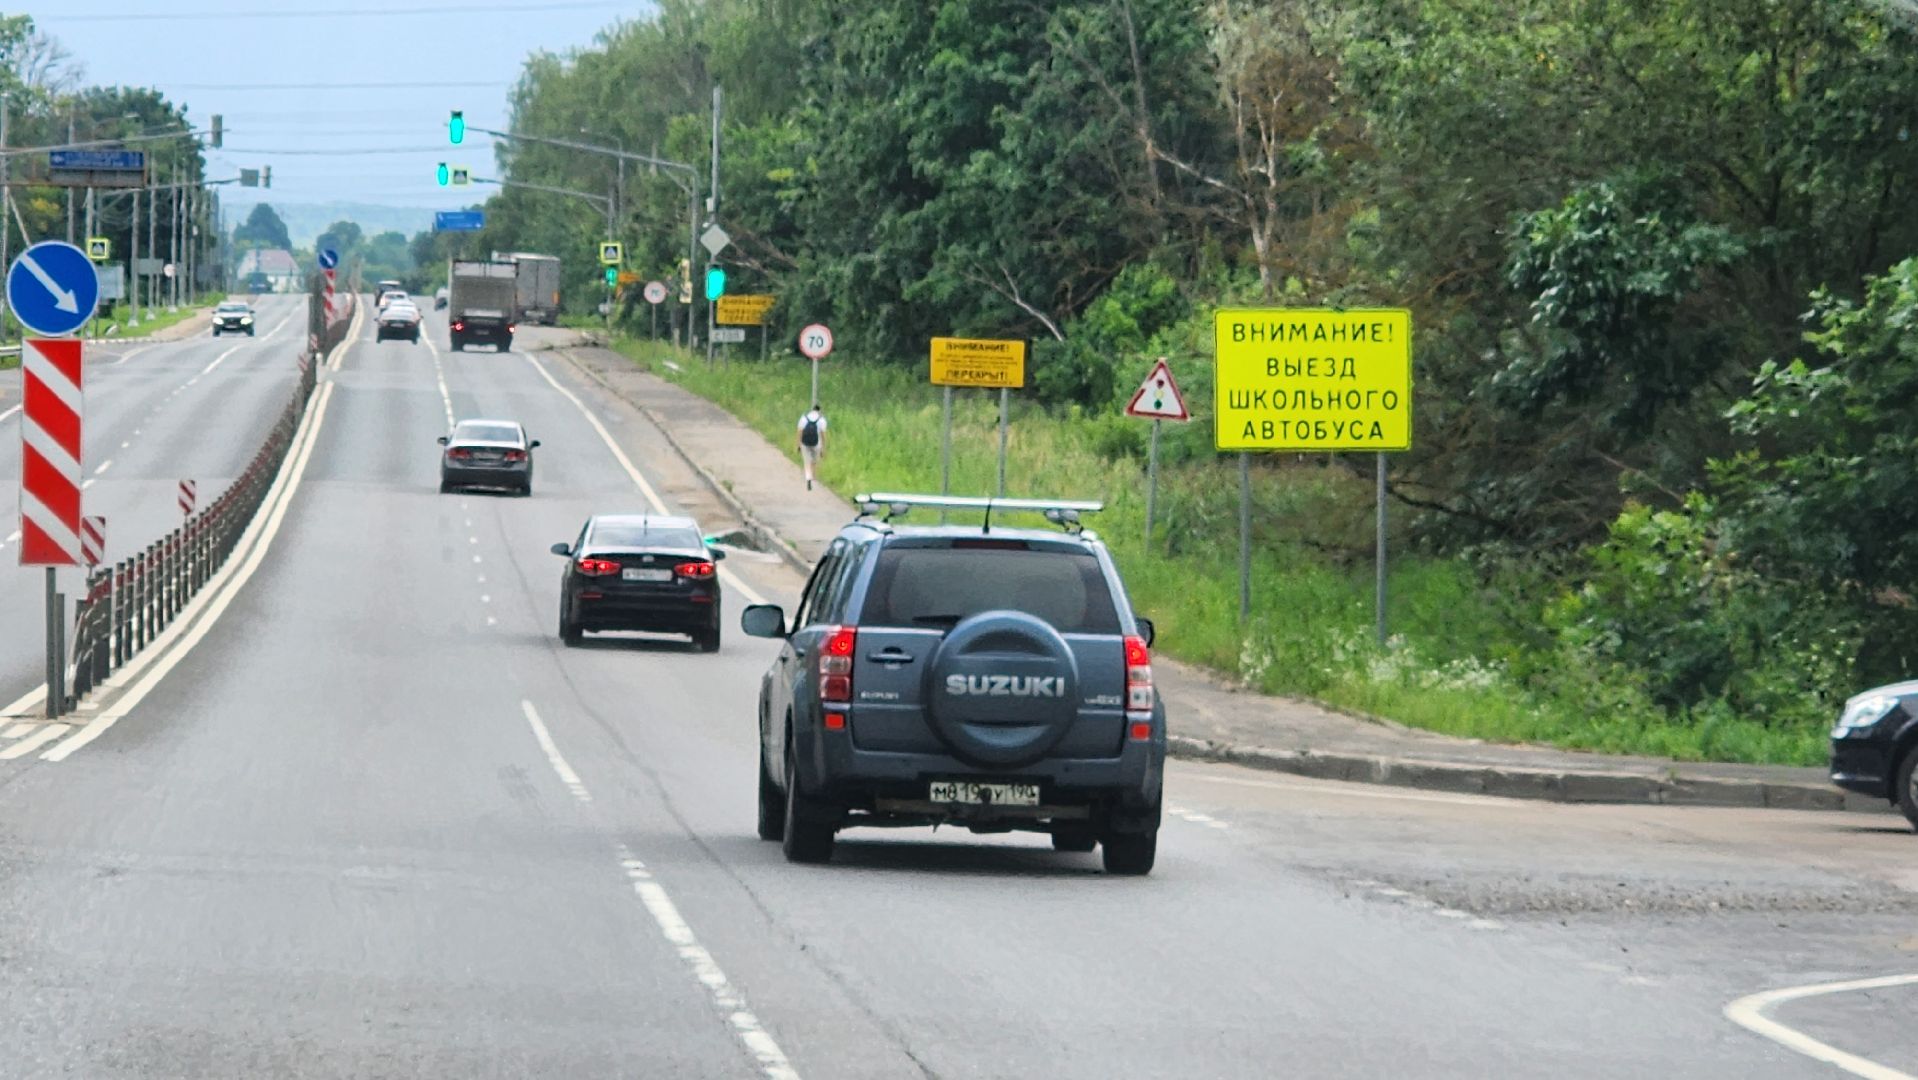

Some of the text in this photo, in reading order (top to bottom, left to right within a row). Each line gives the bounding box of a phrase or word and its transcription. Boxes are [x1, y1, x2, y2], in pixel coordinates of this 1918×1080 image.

[808, 336, 824, 348] 70
[1232, 322, 1393, 342] ВНИМАНИЕ!
[945, 342, 1010, 353] ВНИМАНИЕ!
[1266, 357, 1356, 380] ВЫЕЗД
[1229, 389, 1398, 410] ШКОЛЬНОГО
[1242, 420, 1384, 440] АВТОБУСА
[946, 674, 1065, 697] SUZUKI
